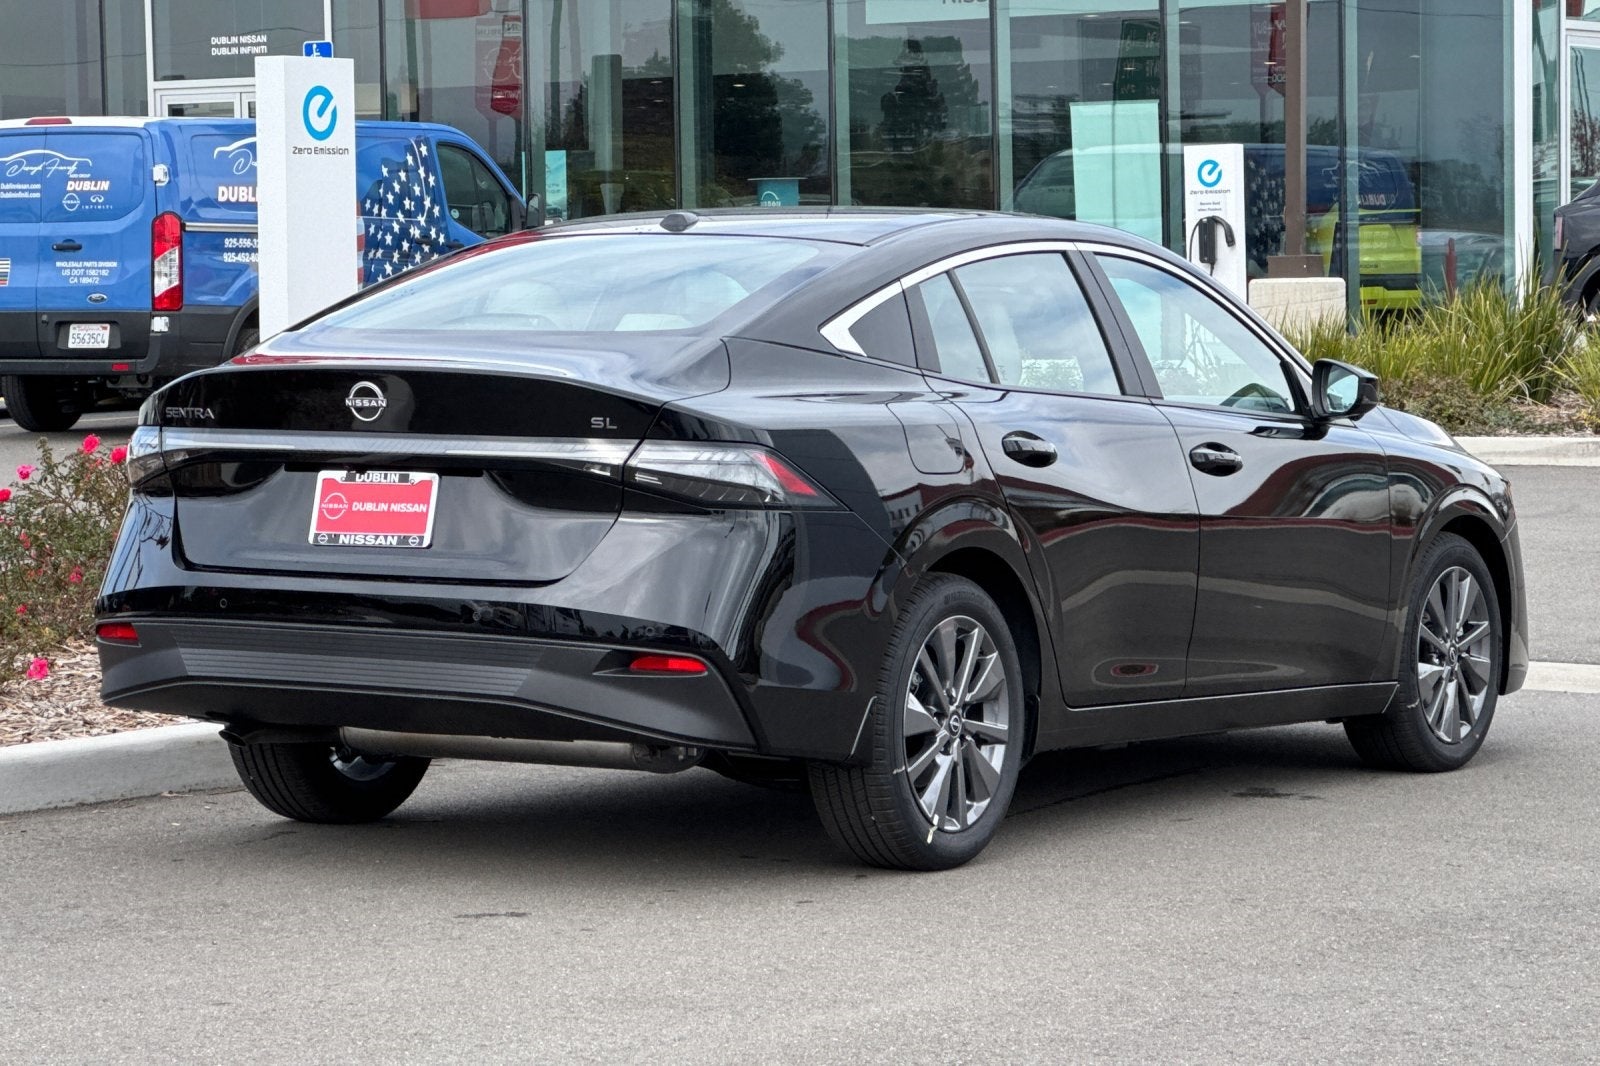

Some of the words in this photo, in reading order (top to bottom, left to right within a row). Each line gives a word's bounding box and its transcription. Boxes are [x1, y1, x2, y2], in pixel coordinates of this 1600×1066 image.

[211, 37, 238, 45] DUBLIN
[240, 35, 267, 43] NISSAN
[211, 47, 238, 55] DUBLIN
[240, 46, 267, 54] INFINITI
[292, 146, 312, 155] Zero
[314, 146, 349, 155] Emission
[66, 180, 110, 191] DUBLIN
[345, 399, 387, 407] NISSAN
[165, 407, 215, 419] SENTRA
[590, 417, 617, 429] SL
[355, 473, 399, 483] DUBLIN
[352, 502, 388, 512] DUBLIN
[390, 504, 427, 513] NISSAN
[339, 534, 398, 545] NISSAN
